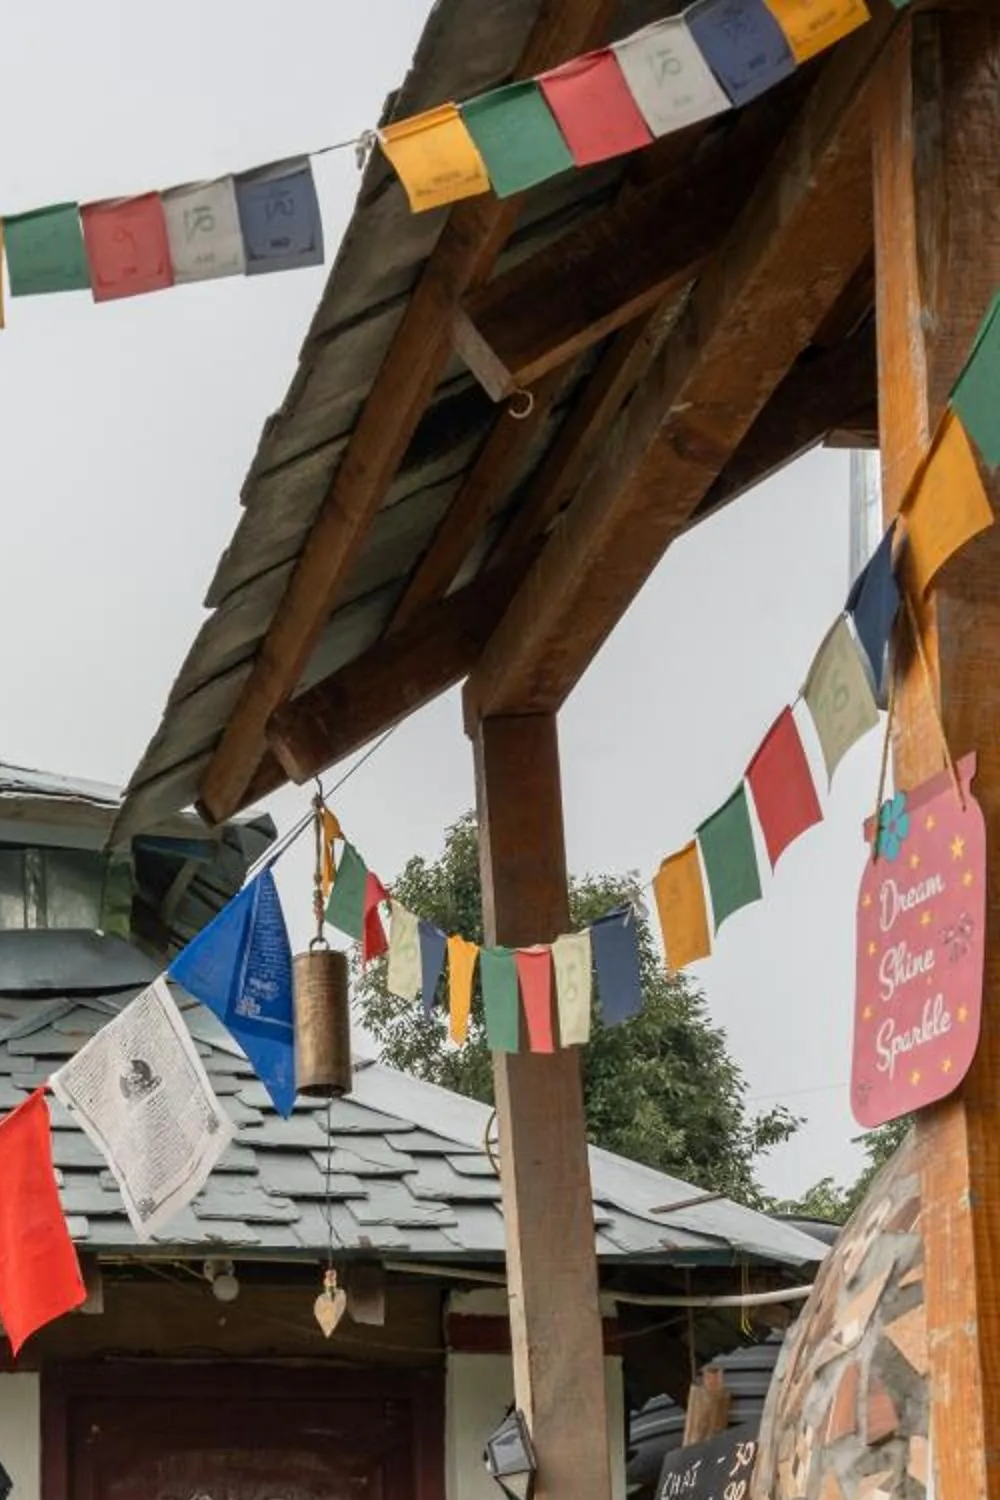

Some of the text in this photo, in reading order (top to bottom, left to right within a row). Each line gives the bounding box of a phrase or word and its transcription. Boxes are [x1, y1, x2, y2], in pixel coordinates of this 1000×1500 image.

[879, 873, 946, 931] Dream
[878, 942, 935, 1002] Shine
[875, 993, 952, 1080] Sparkle
[729, 1441, 755, 1477] 30
